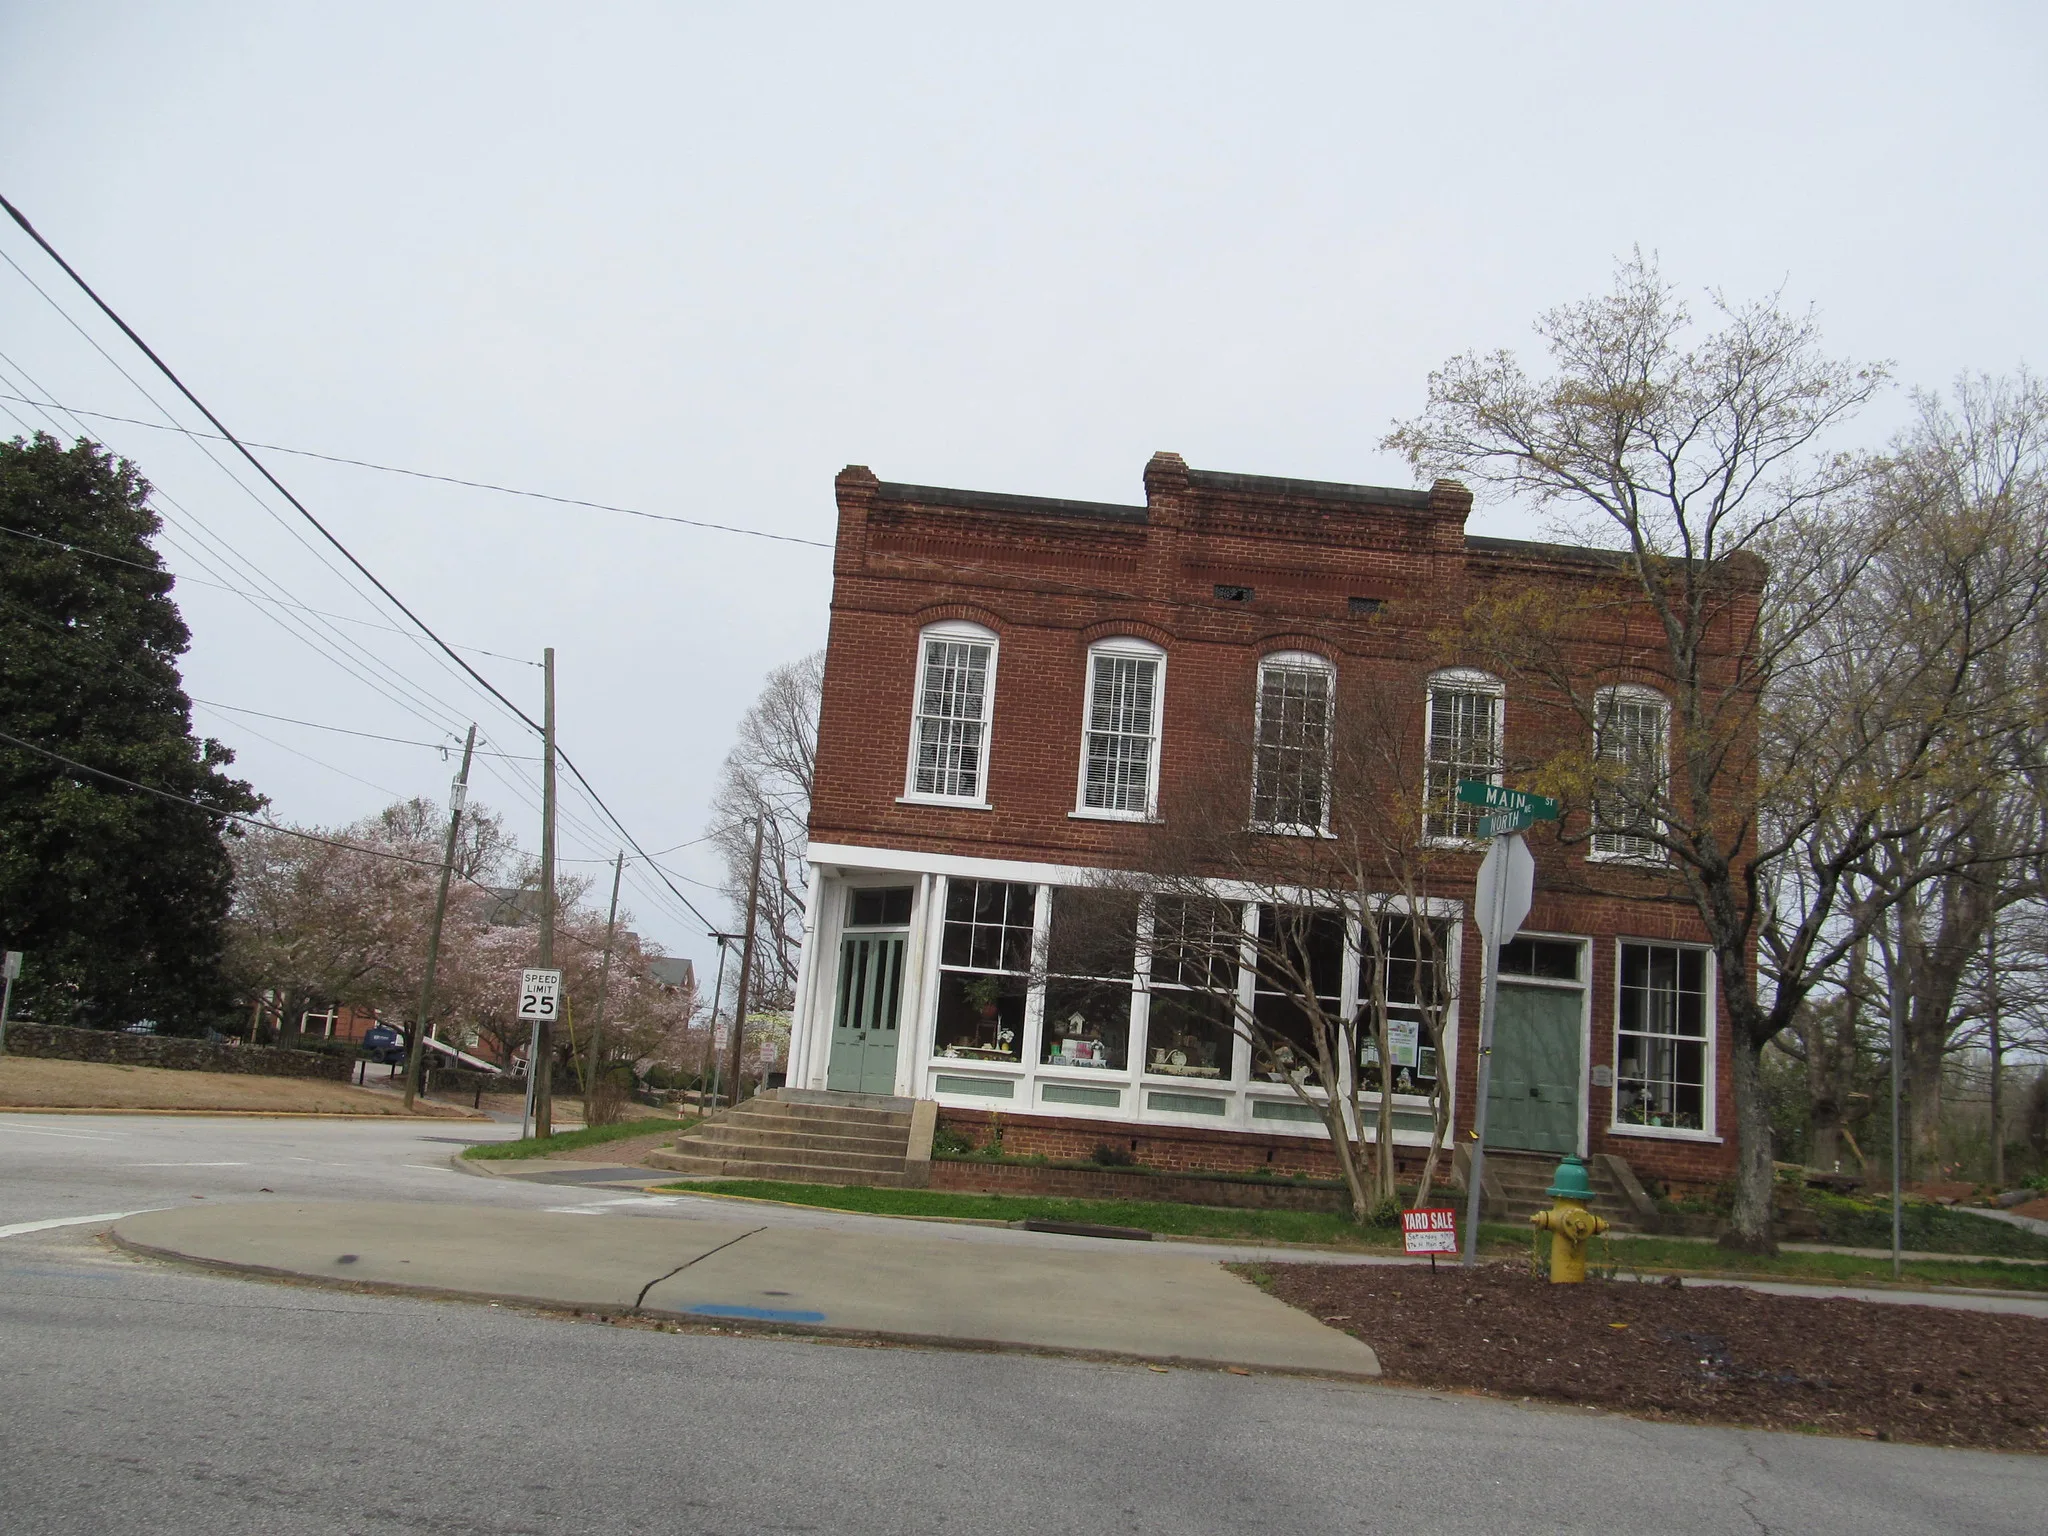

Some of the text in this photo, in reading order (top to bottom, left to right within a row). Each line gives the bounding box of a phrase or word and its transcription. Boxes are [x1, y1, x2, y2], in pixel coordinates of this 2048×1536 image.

[1486, 788, 1525, 809] MAIN
[1545, 797, 1554, 807] ST
[1490, 810, 1520, 833] NORTH
[525, 974, 557, 984] SPEED
[527, 985, 552, 993] LIMIT
[522, 995, 554, 1014] 25
[1404, 1212, 1453, 1230] YARD SALE
